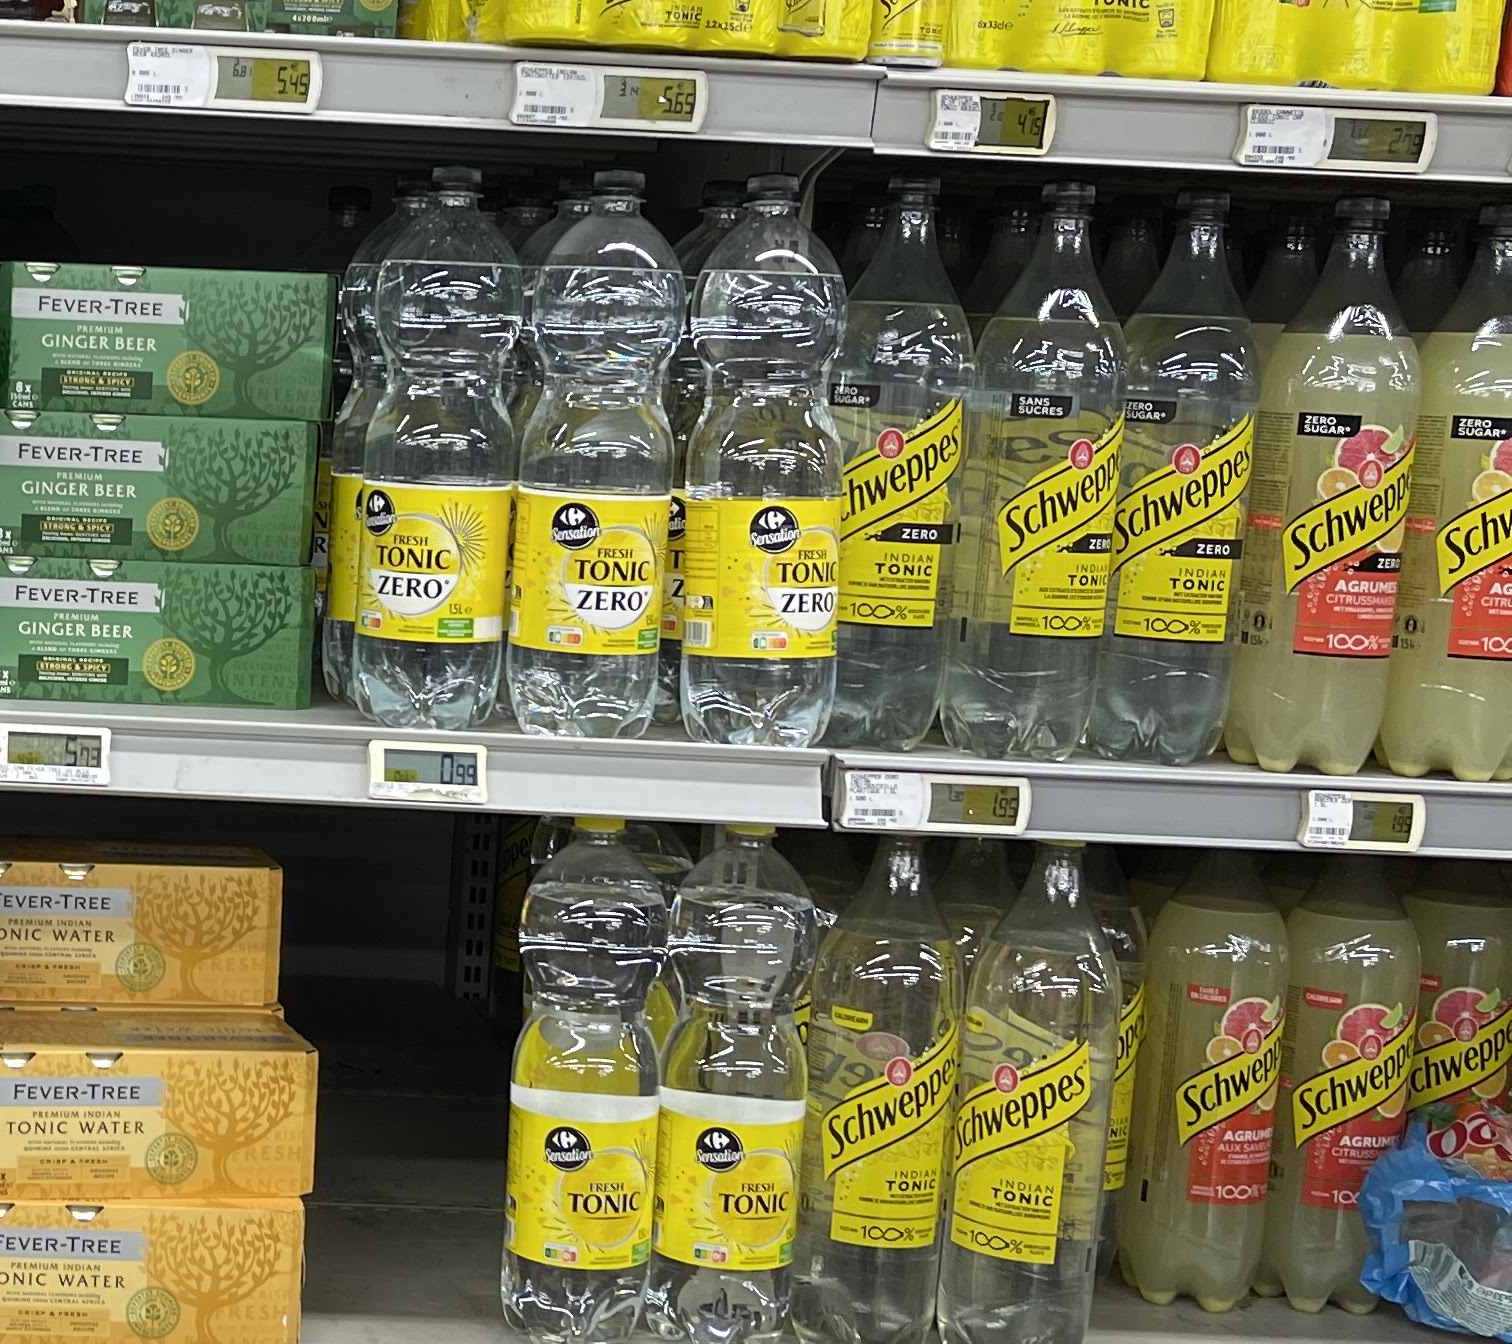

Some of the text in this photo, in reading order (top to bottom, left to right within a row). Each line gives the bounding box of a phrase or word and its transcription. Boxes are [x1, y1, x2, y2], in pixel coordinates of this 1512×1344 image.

[666, 11, 702, 21] TONIC
[38, 296, 163, 317] FEVER-TREE
[76, 324, 124, 334] PREMIUM
[41, 333, 157, 351] GINGER BEER
[1018, 396, 1051, 406] SANS
[1018, 405, 1064, 416] SUCRES
[1304, 415, 1337, 426] ZERO
[392, 533, 429, 545] FRESH
[551, 523, 602, 543] Sensation
[901, 528, 938, 541] ZERO
[1196, 543, 1231, 555] ZERO
[376, 544, 450, 569] TONIC
[883, 552, 933, 564] INDIAN
[575, 559, 650, 583] TONIC
[875, 563, 932, 576] TONIC
[1178, 568, 1226, 579] INDIAN
[378, 576, 442, 599] ZERO
[1170, 578, 1225, 592] TONIC
[577, 590, 644, 610] ZERO
[8, 919, 51, 927] PREMIUM
[52, 929, 115, 943] WATER
[954, 1064, 1088, 1160] Schweppes
[590, 1182, 625, 1193] FRESH
[999, 1179, 1054, 1194] INDIAN
[991, 1186, 1053, 1206] TONIC
[568, 1192, 639, 1214] TONIC
